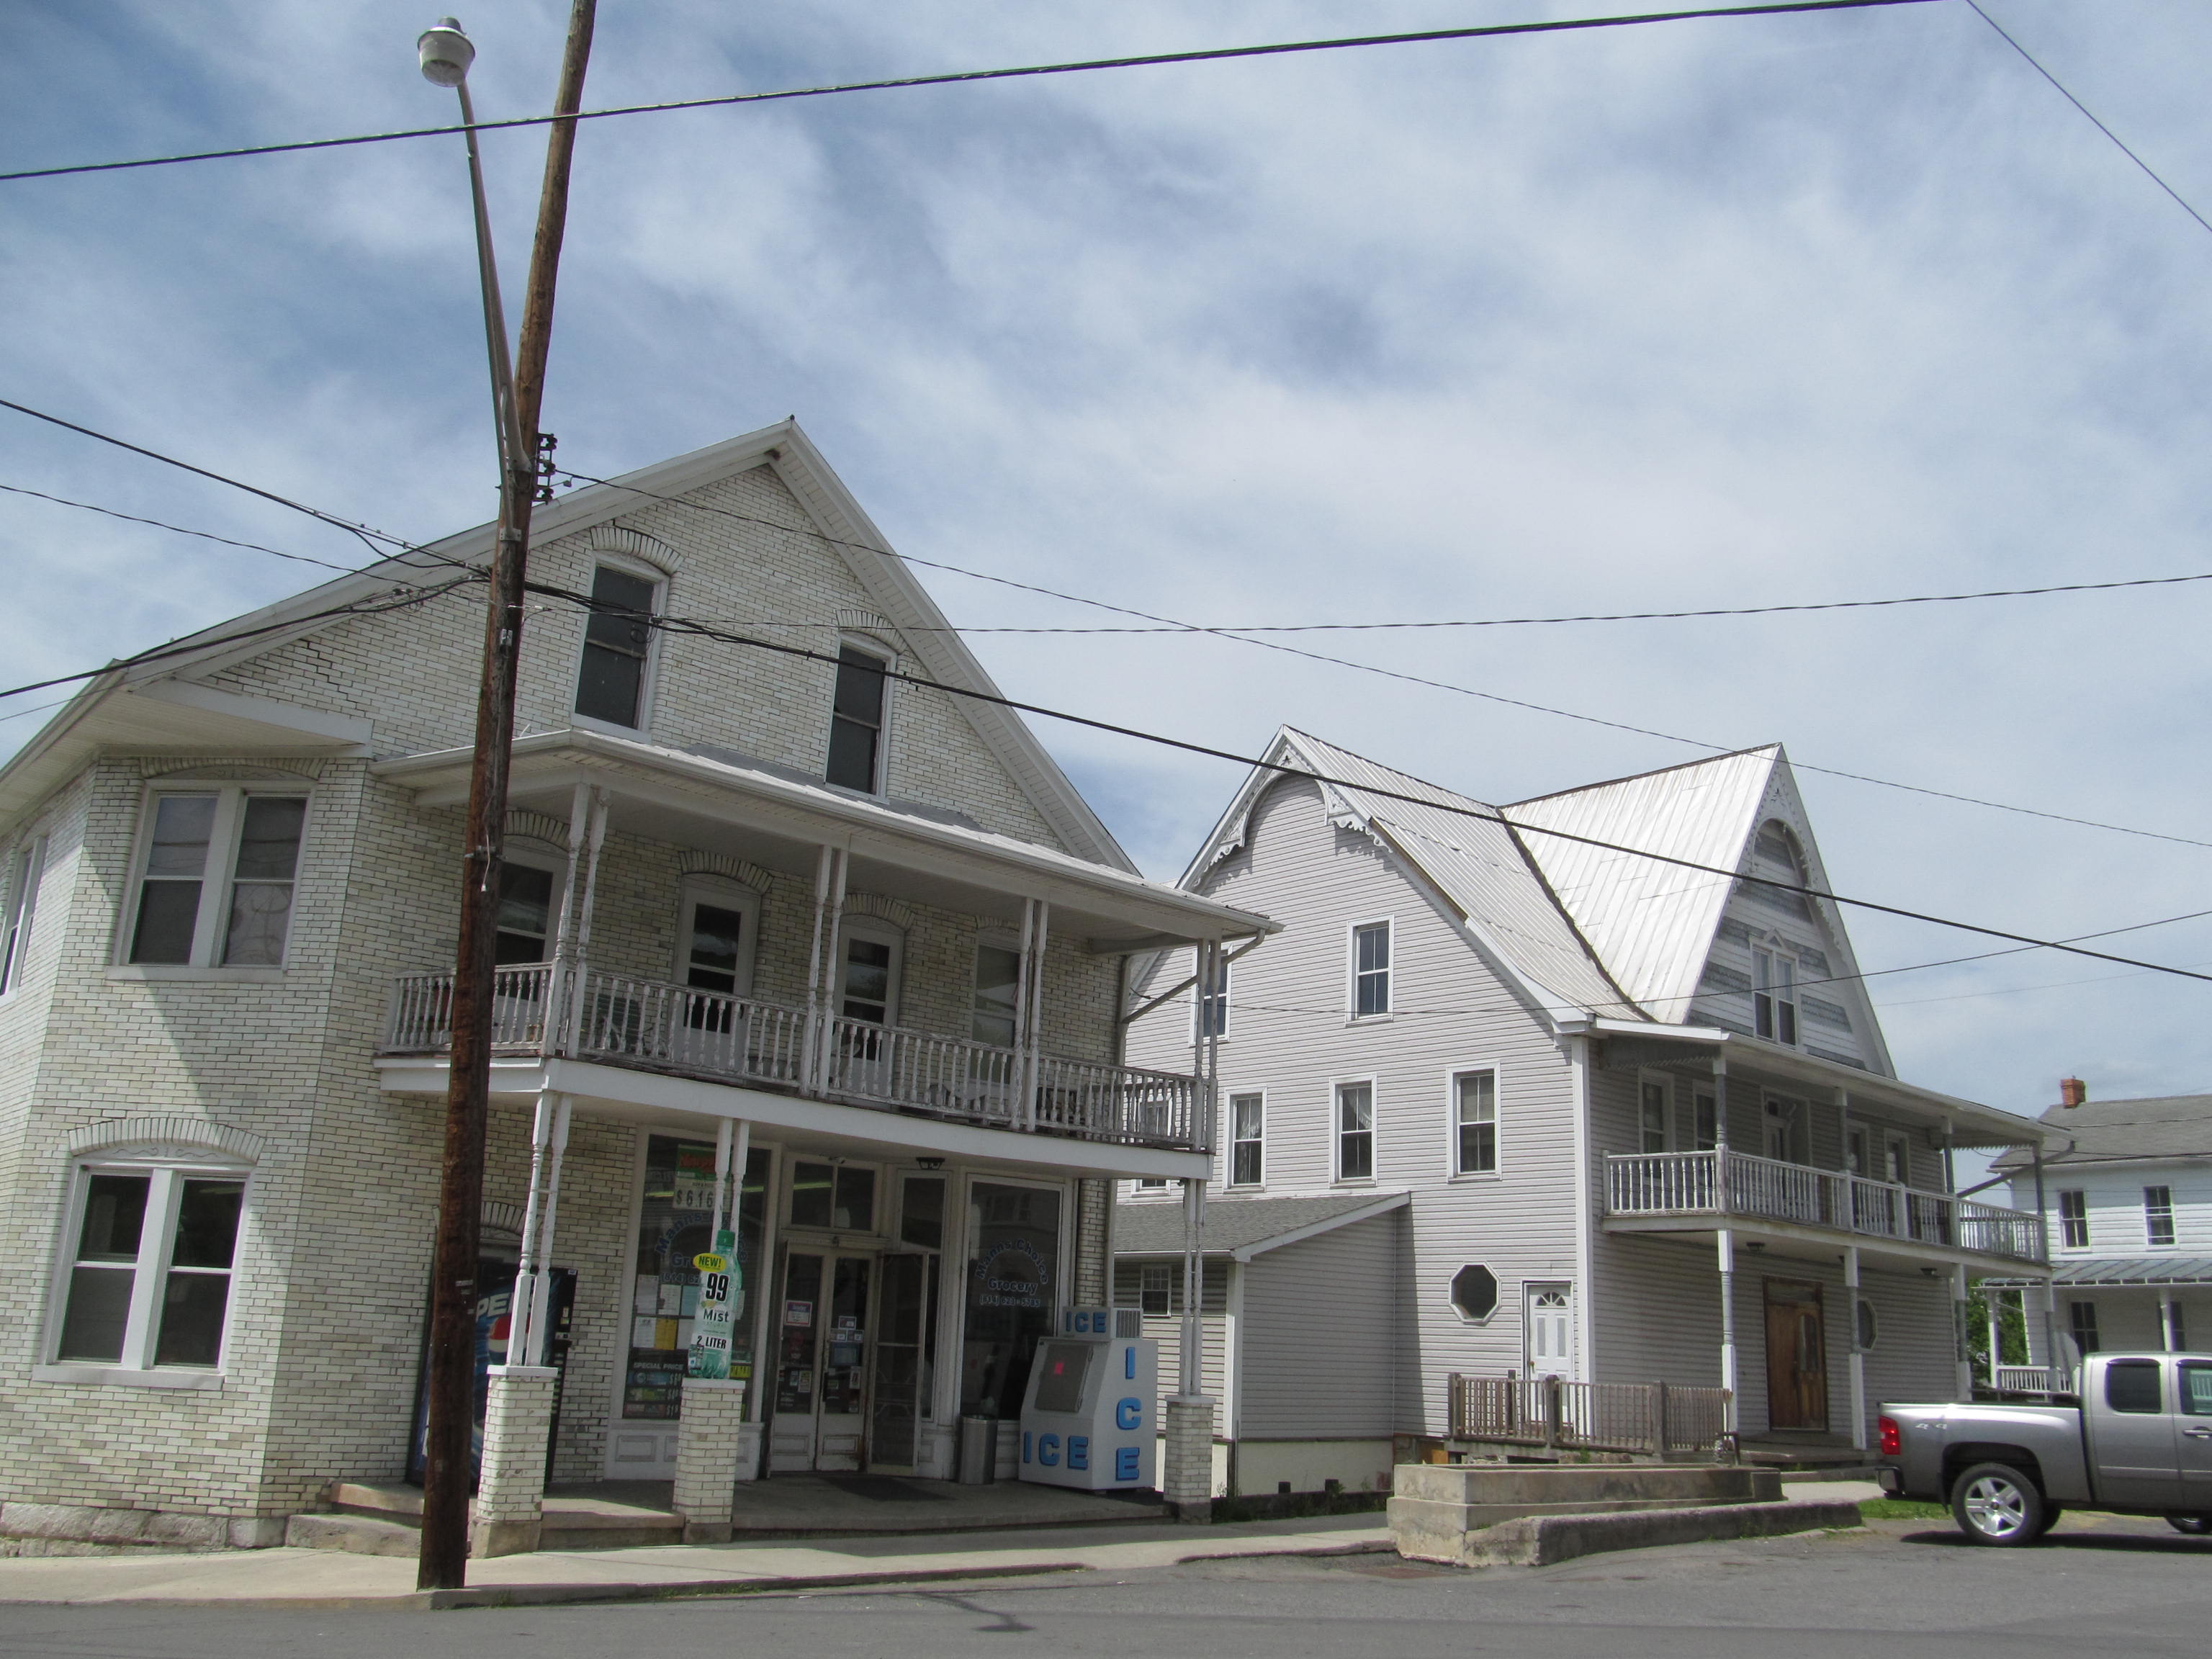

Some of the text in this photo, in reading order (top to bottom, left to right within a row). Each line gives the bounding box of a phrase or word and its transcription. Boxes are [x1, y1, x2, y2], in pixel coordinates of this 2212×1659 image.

[698, 1256, 721, 1268] NEW!
[1016, 1238, 1048, 1284] Choice
[988, 1277, 1038, 1295] Grocery
[703, 1308, 729, 1323] Mist
[1066, 1311, 1107, 1333] ICE
[697, 1336, 727, 1349] 2 LITER
[1116, 1347, 1142, 1481] ICE
[1023, 1431, 1089, 1470] ICE
